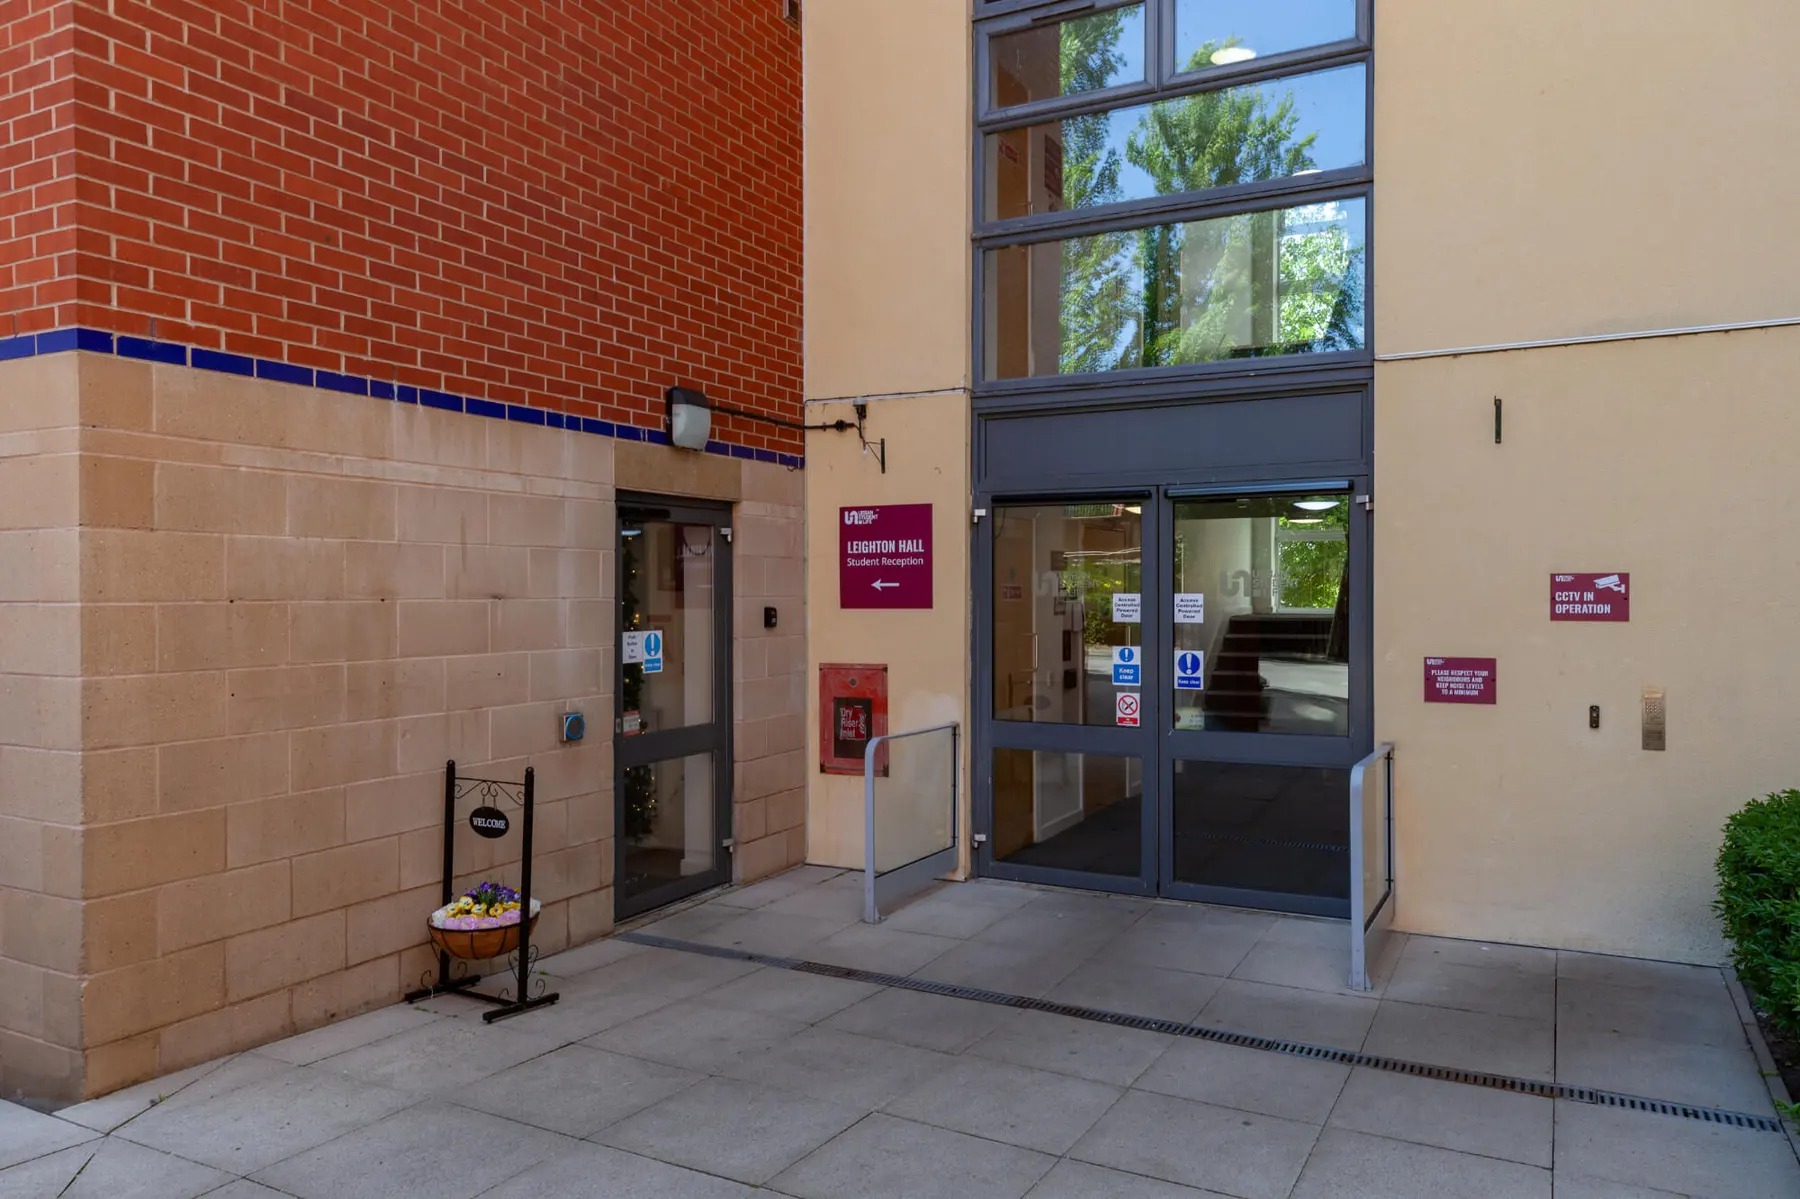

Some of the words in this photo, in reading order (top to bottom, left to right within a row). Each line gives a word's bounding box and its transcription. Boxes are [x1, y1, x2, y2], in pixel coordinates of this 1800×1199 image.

[847, 540, 896, 554] LEIGHTON
[899, 539, 925, 553] HALL
[847, 557, 880, 567] Student
[881, 556, 924, 568] Reception
[1555, 591, 1581, 601] CCTV
[1583, 591, 1594, 601] IN
[1555, 603, 1611, 614] OPERATION
[840, 707, 853, 719] Dry
[840, 718, 859, 728] Riser
[840, 727, 856, 738] Inlet
[472, 817, 506, 829] WELCOME
